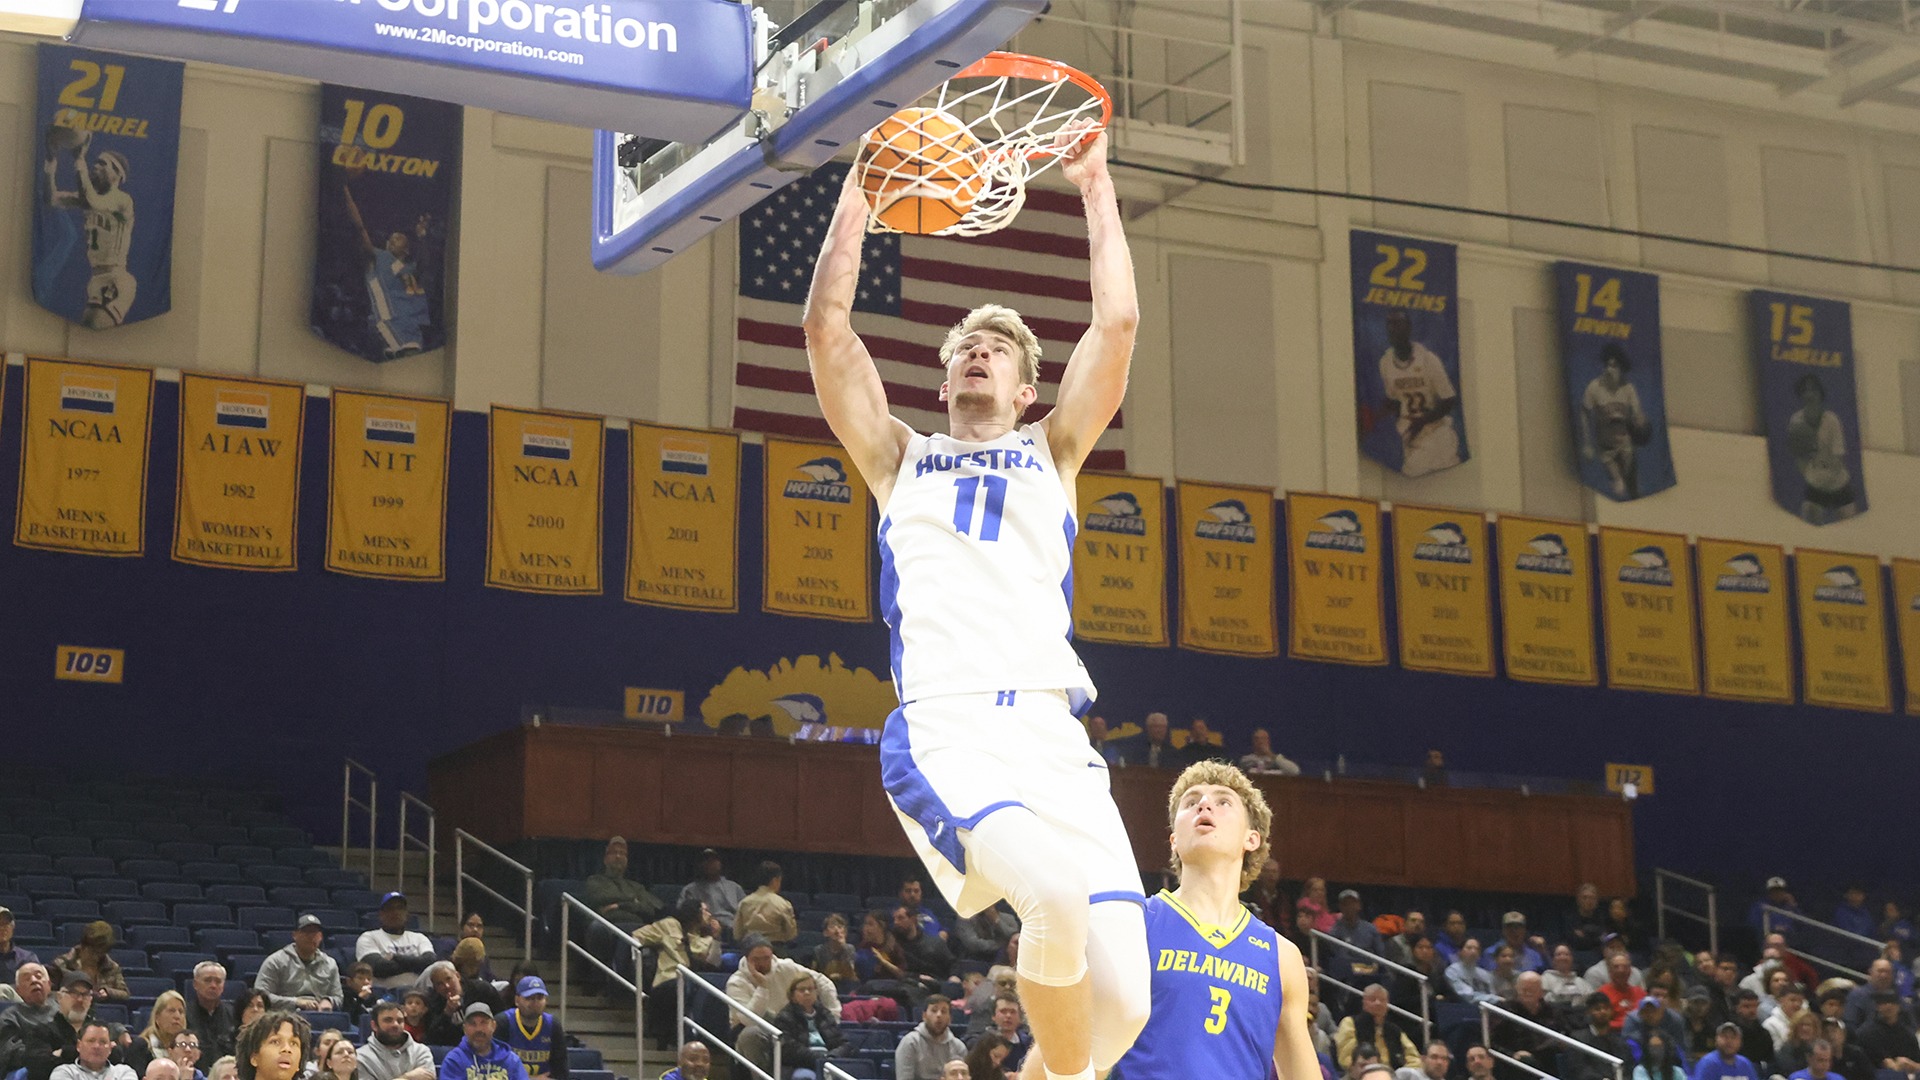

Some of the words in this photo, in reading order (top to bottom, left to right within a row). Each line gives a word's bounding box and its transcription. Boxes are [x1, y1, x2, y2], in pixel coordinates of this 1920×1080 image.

[375, 22, 584, 65] www.2Mcorporation.com
[58, 60, 125, 111] 21
[54, 108, 148, 138] LAUREL
[340, 100, 404, 148] 10
[332, 145, 439, 177] CLAXTON
[1369, 245, 1427, 290] 22
[1363, 288, 1447, 313] JENKINS
[1575, 274, 1623, 318] 14
[1770, 302, 1814, 345] 15
[49, 419, 122, 443] NCAA
[201, 432, 282, 457] AIAW
[362, 449, 416, 472] NIT
[916, 449, 1043, 478] HOFSTRA
[67, 467, 100, 481] 1977
[514, 465, 579, 487] NCAA
[223, 483, 256, 498] 1982
[652, 480, 716, 503] NCAA
[786, 481, 850, 498] HOFSTRA
[372, 496, 404, 508] 1999
[953, 474, 1008, 541] 11
[57, 507, 106, 524] MEN'S
[527, 514, 565, 529] 2000
[794, 510, 842, 531] NIT
[1086, 514, 1144, 531] HOFSTRA
[29, 523, 129, 544] BASKETBALL
[201, 521, 273, 540] WOMEN'S
[668, 526, 699, 542] 2001
[1198, 521, 1255, 538] HOFSTRA
[187, 538, 283, 559] BASKETBALL
[363, 534, 411, 550] MEN'S
[1085, 540, 1149, 563] WNIT
[338, 549, 430, 569] BASKETBALL
[520, 551, 572, 568] MEN'S
[1205, 552, 1249, 572] NIT
[500, 569, 588, 587] BASKETBALL
[661, 565, 706, 580] MEN'S
[1304, 559, 1369, 582] WNIT
[638, 580, 726, 600] BASKETBALL
[797, 576, 840, 590] MEN'S
[1415, 571, 1471, 592] WNIT
[775, 591, 858, 611] BASKETBALL
[1080, 619, 1153, 635] BASKETBALL
[65, 652, 112, 674] 109
[637, 694, 672, 715] 110
[1248, 936, 1270, 951] CAA
[1157, 949, 1270, 994] DELAWARE
[1204, 985, 1232, 1035] 3
